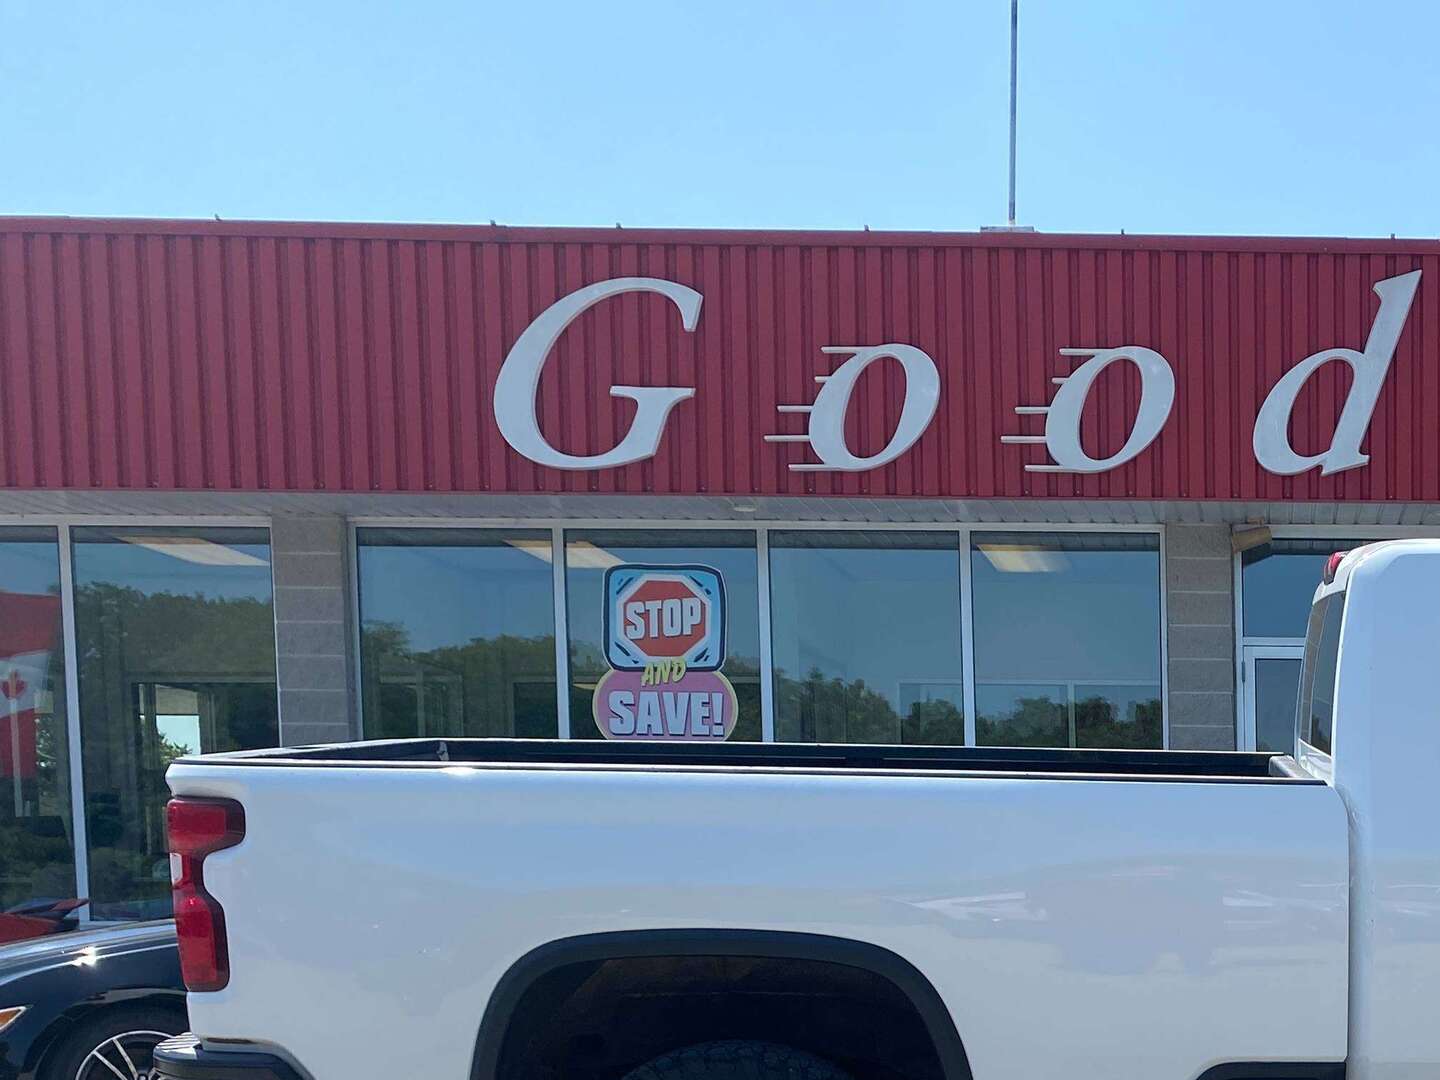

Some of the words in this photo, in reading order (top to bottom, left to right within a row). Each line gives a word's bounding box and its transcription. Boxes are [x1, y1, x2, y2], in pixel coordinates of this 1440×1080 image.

[625, 596, 702, 640] STOP
[641, 659, 687, 687] AND
[608, 690, 726, 738] SAVE!
